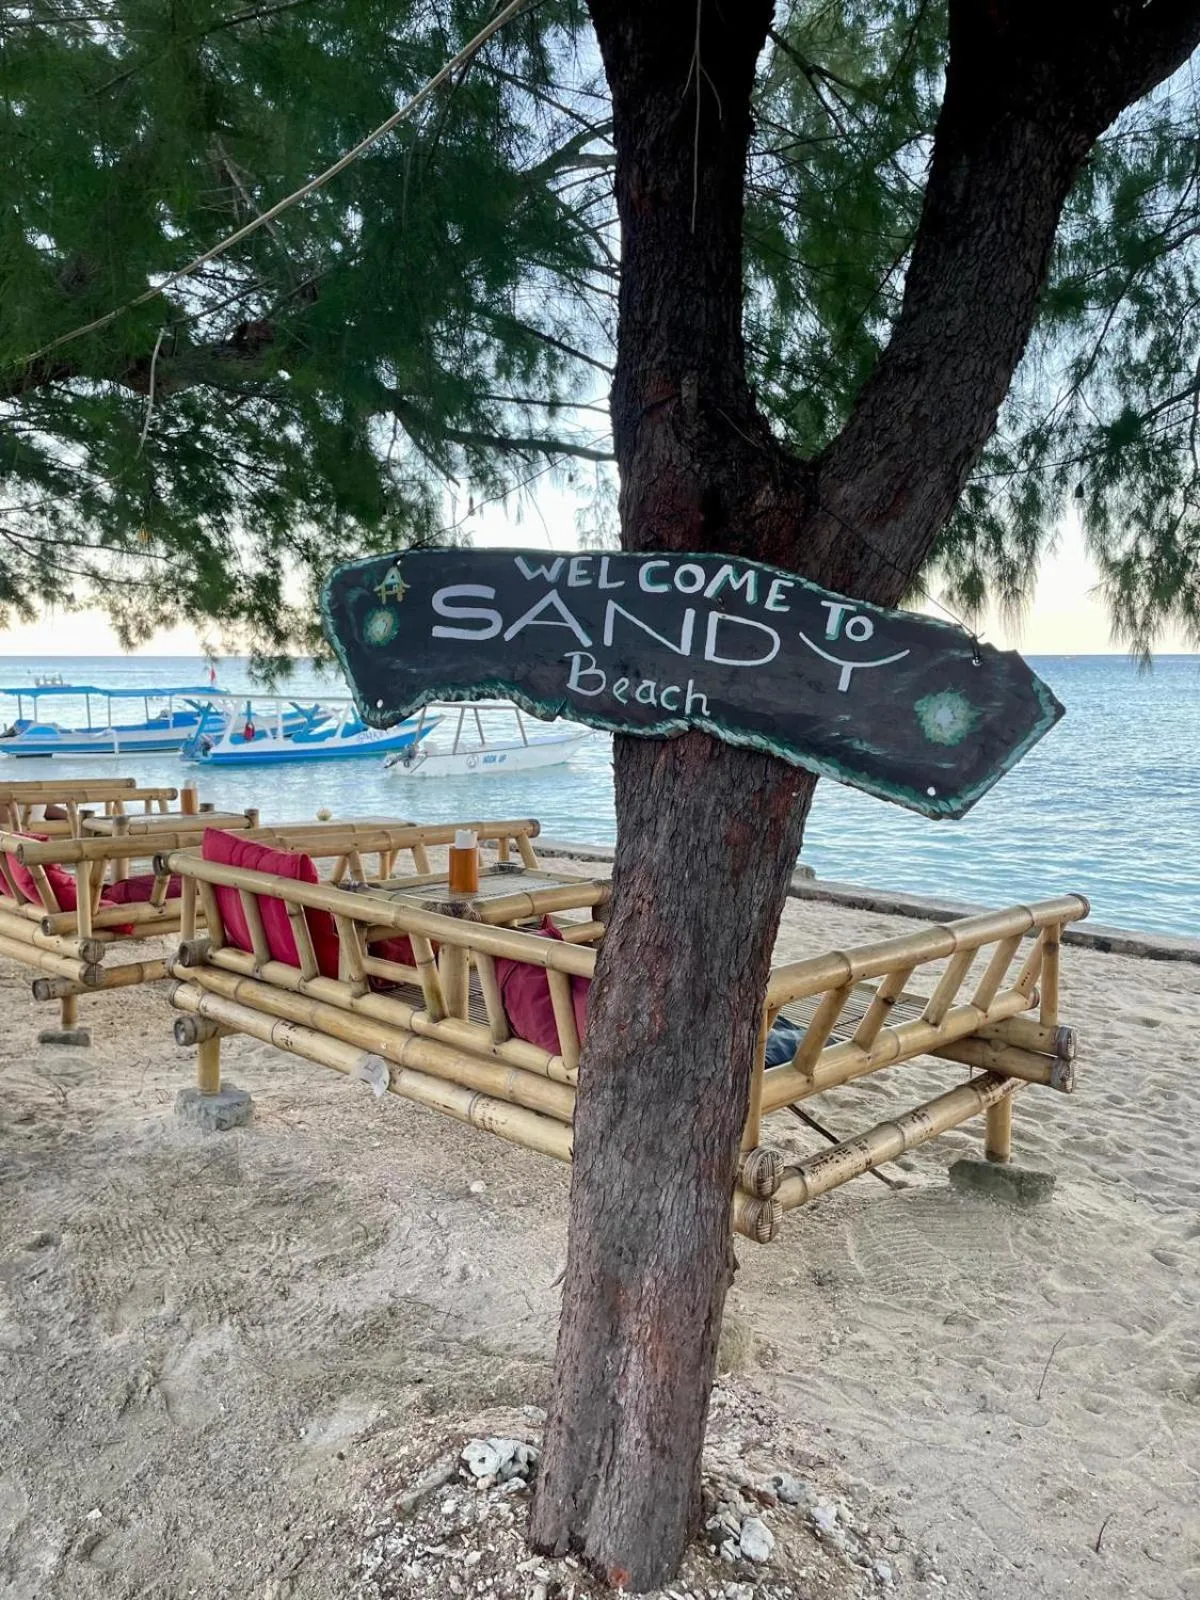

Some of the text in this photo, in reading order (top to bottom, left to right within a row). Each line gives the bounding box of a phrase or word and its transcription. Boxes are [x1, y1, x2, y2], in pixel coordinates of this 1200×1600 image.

[513, 555, 795, 612] WELCOME
[431, 583, 911, 692] SANDY
[563, 651, 711, 716] Beach
